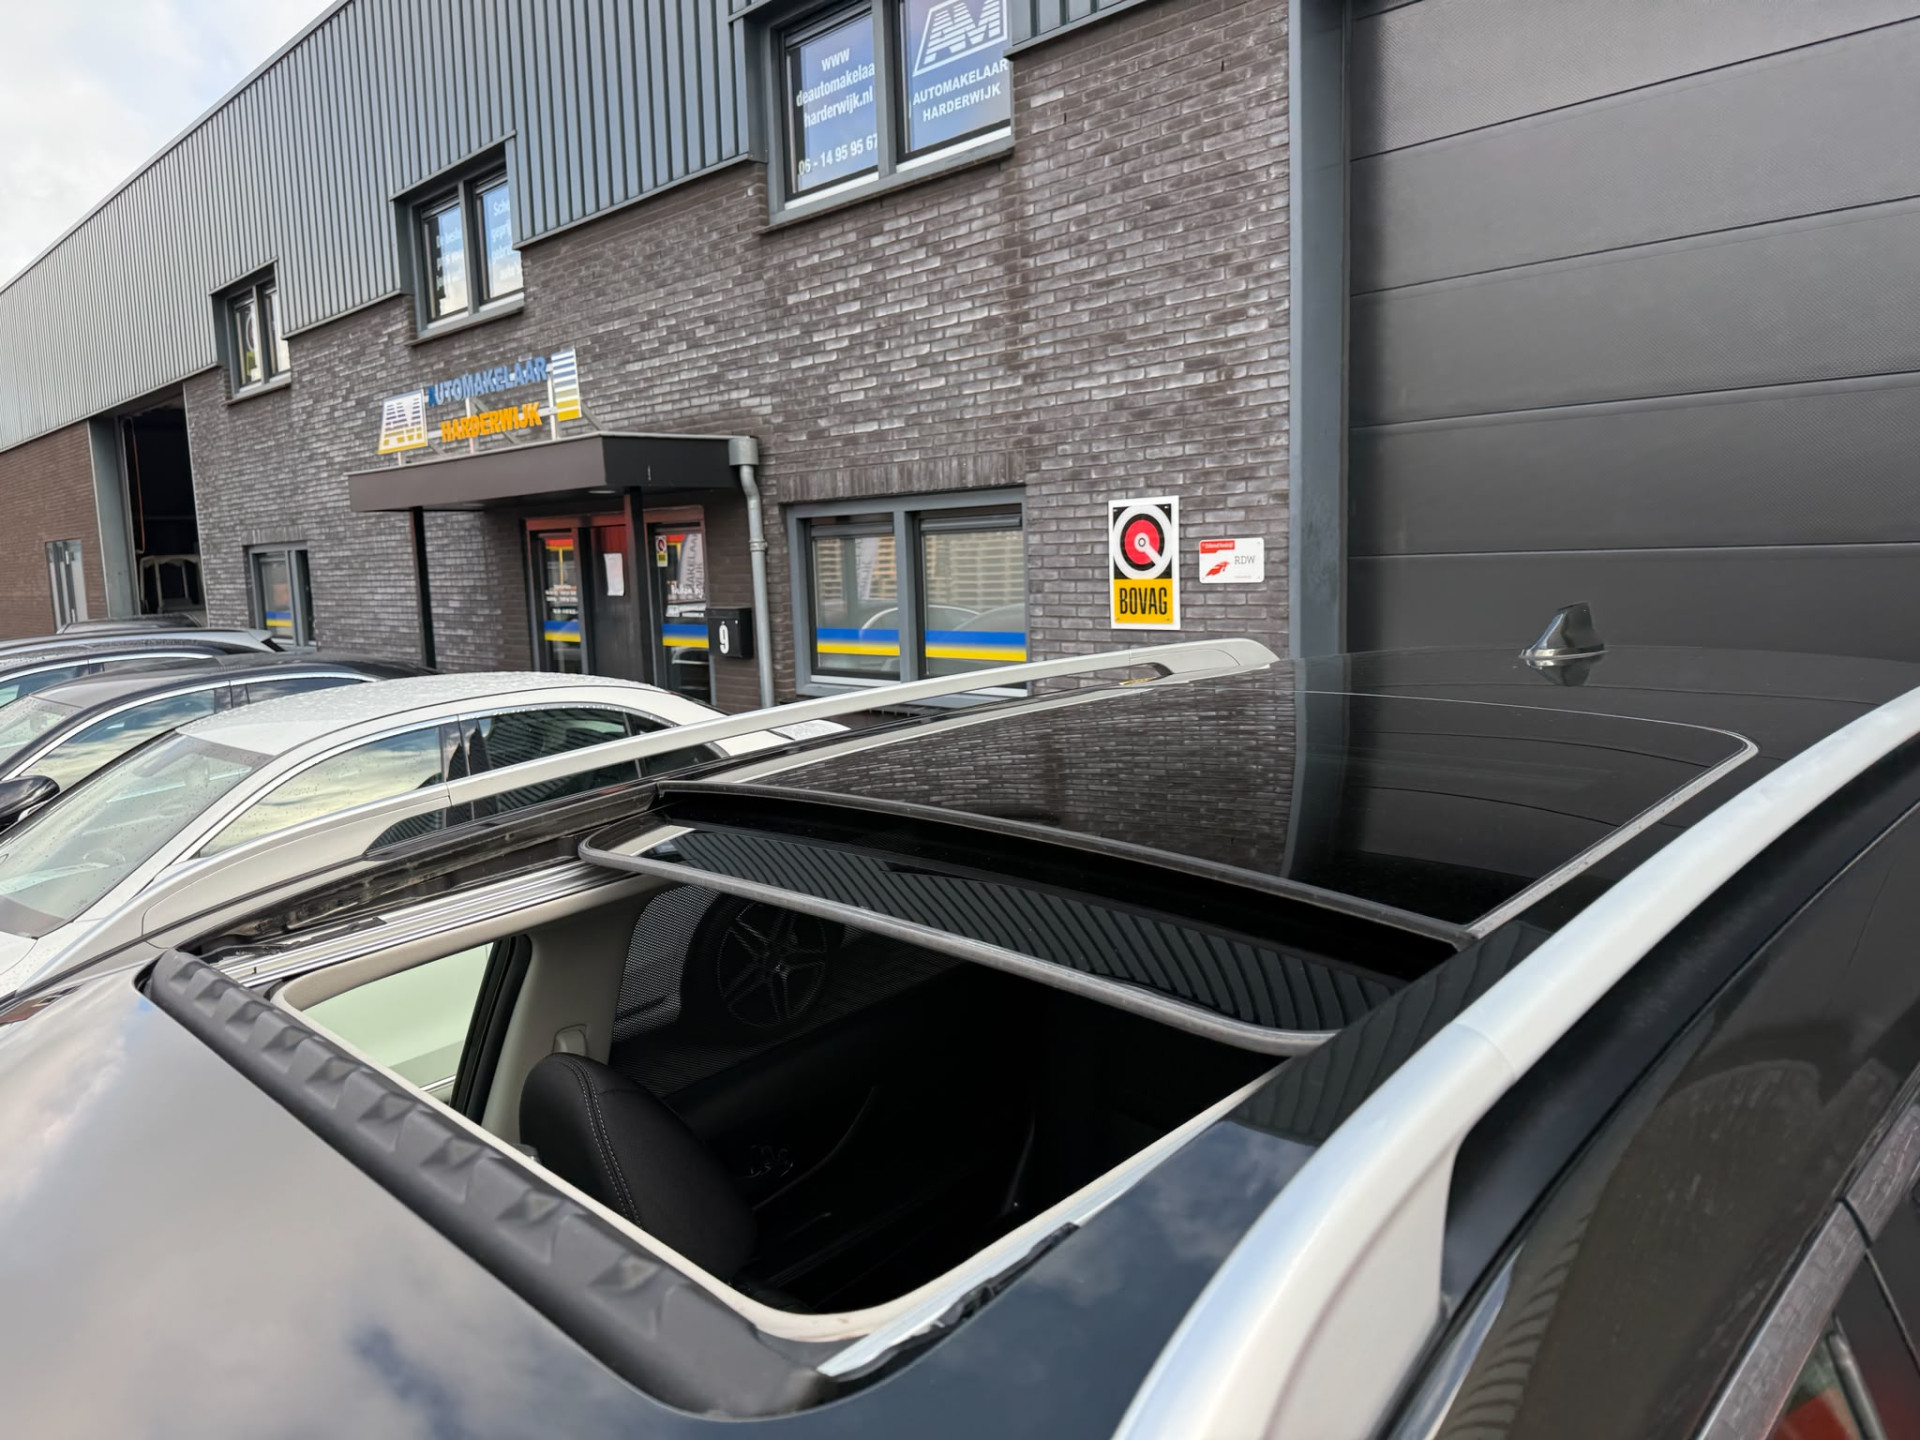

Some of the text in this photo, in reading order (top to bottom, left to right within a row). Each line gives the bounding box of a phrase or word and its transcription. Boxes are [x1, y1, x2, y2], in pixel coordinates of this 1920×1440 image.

[821, 48, 850, 72] www
[912, 58, 1009, 106] AUTOMAKELAAR
[803, 85, 873, 128] harderwijk.nl
[922, 82, 1001, 122] HARDERWIJK
[798, 158, 811, 176] 06
[820, 149, 834, 168] 14
[835, 144, 848, 162] 95
[850, 138, 863, 156] 95
[441, 402, 543, 442] HARDERWIJK
[1234, 555, 1256, 565] RDW
[1119, 586, 1168, 615] BOVAG
[719, 624, 730, 655] 9
